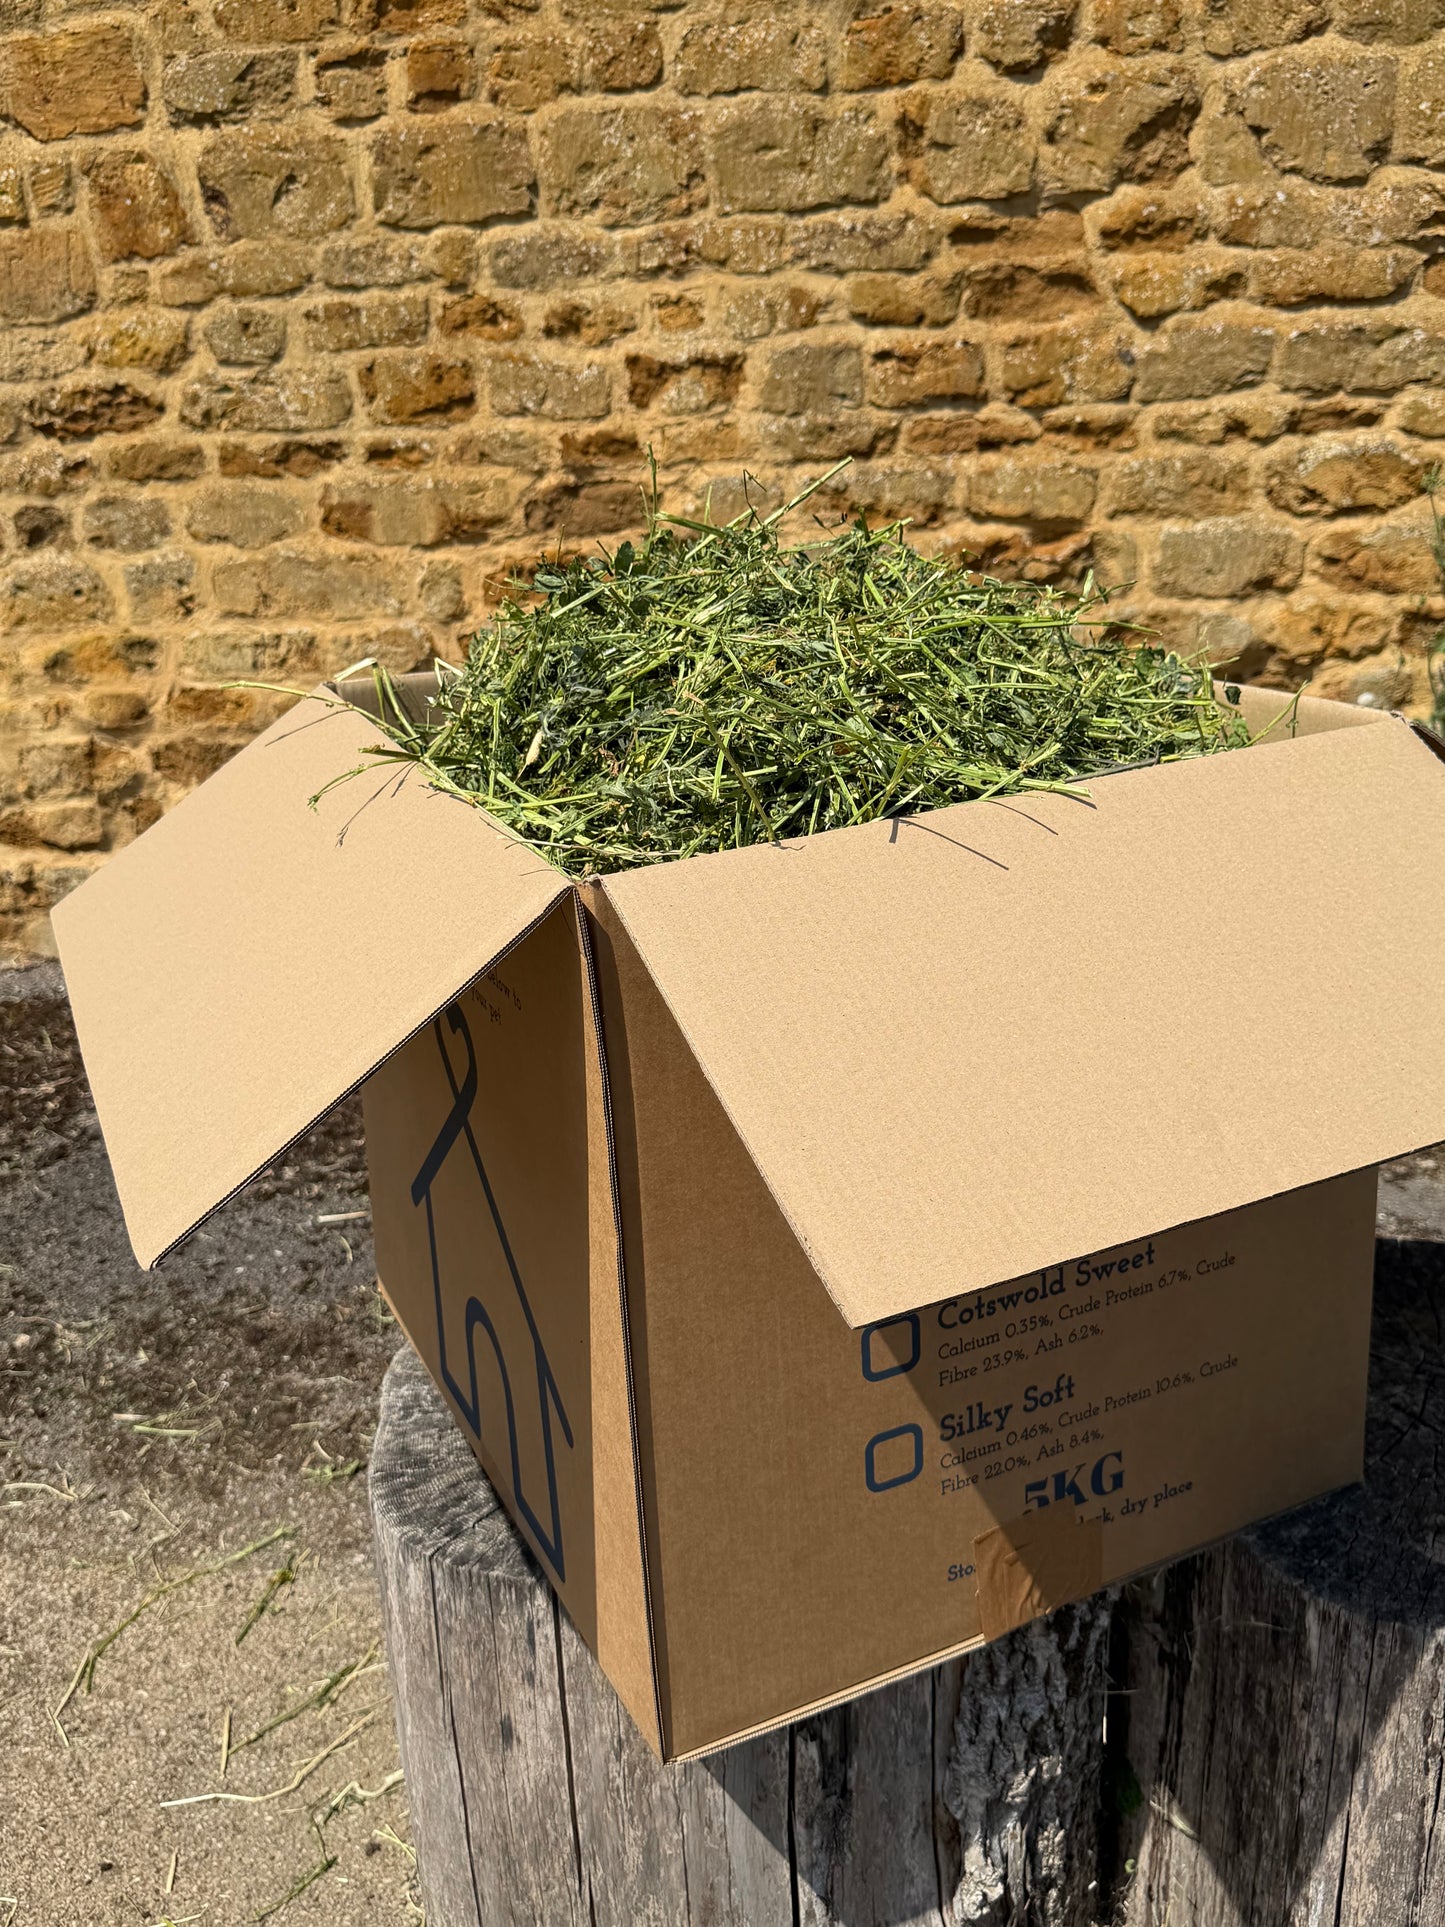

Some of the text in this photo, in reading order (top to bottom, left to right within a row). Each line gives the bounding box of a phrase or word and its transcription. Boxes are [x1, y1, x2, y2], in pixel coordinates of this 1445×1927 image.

[937, 1241, 1156, 1330] Cotswold Sweet
[938, 1251, 1236, 1360] Calcium 0.35%, Crude Protein 6.7%, Crude
[938, 1323, 1105, 1387] Fibre 23.9%, Ash 6.2%,
[939, 1373, 1076, 1442] Silky Soft
[940, 1353, 1239, 1469] Calcium 0.46%, Crude Protein 10.6%, Crude
[941, 1427, 1105, 1496] Fibre 22.0%, Ash 8.4%,
[1022, 1450, 1126, 1516] 5KG
[947, 1480, 1194, 1582] Sto dry place
